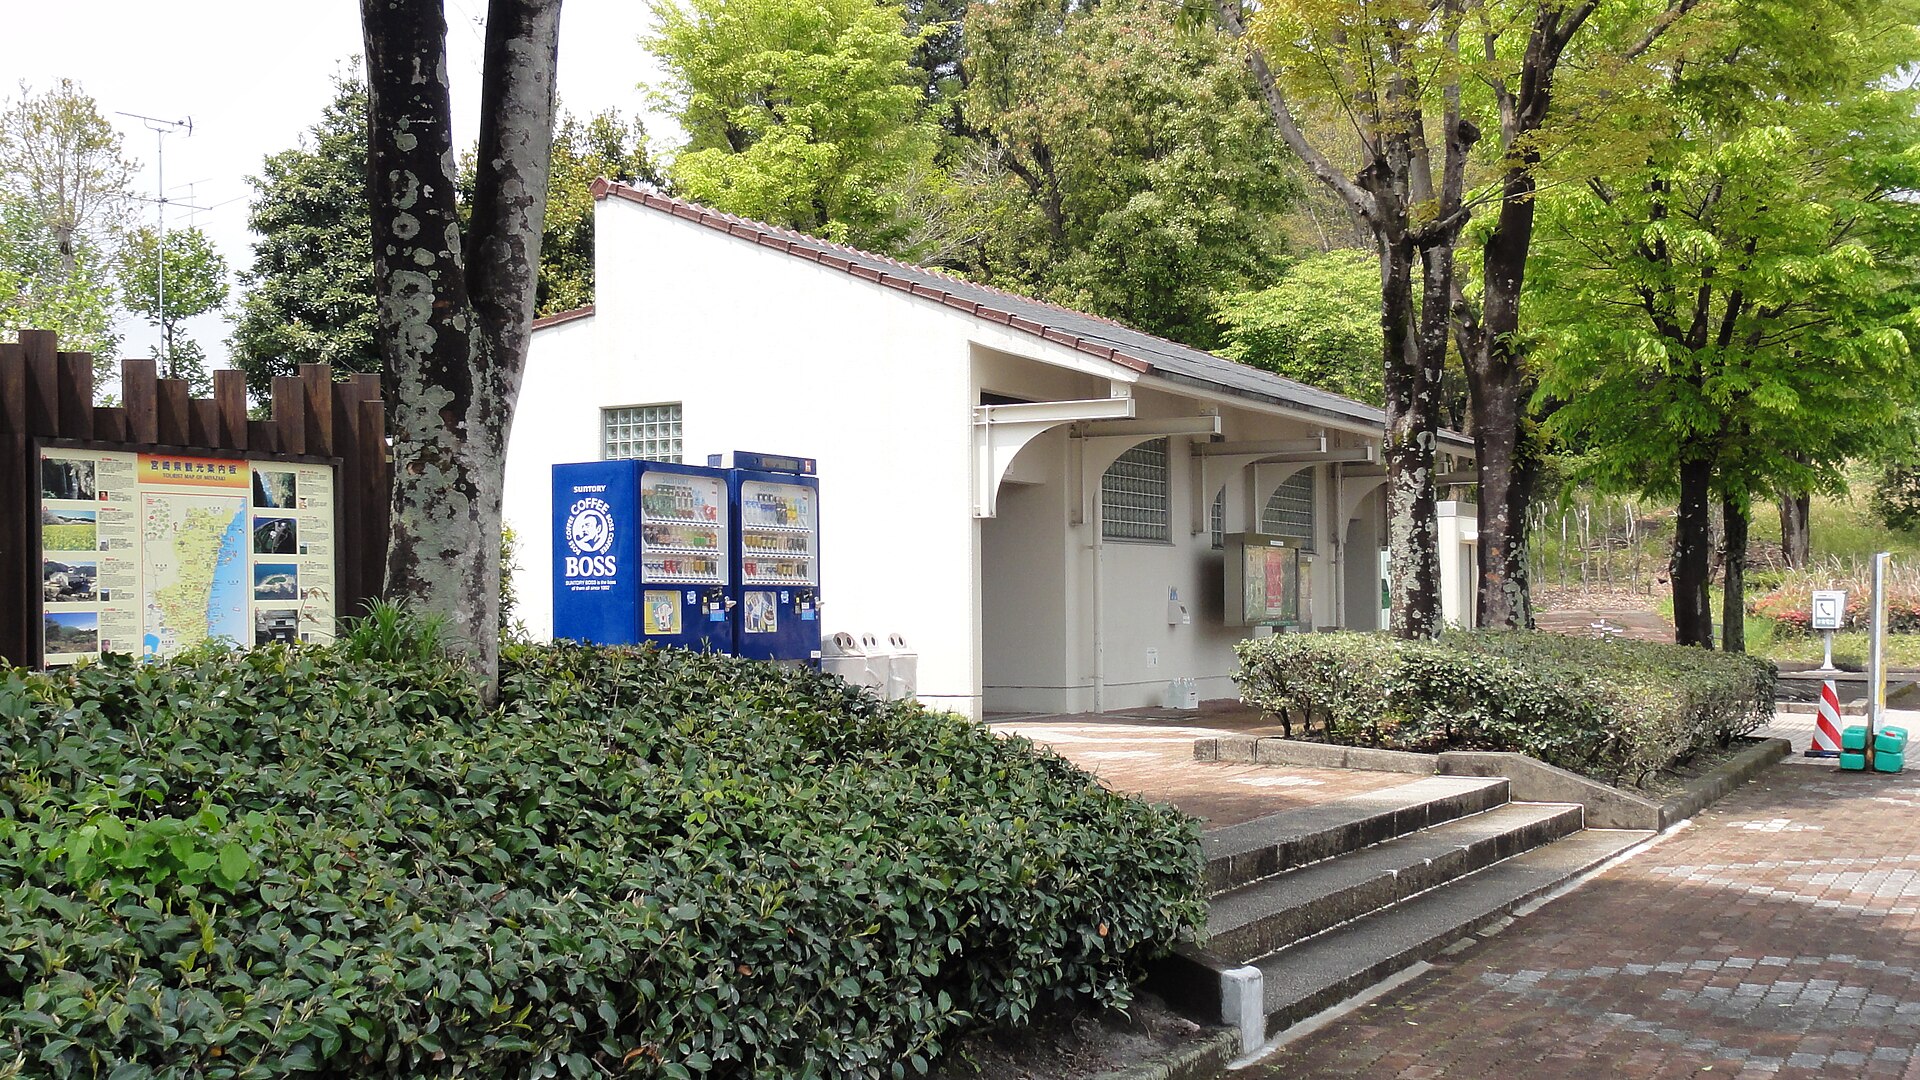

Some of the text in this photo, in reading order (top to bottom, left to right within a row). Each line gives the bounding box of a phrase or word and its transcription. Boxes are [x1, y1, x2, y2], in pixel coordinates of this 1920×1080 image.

[150, 460, 237, 475] 宮崎県観光案内板
[573, 484, 607, 493] SUNTORY
[570, 497, 610, 515] COFFEE
[605, 513, 615, 532] BOSS
[565, 555, 617, 577] BOSS
